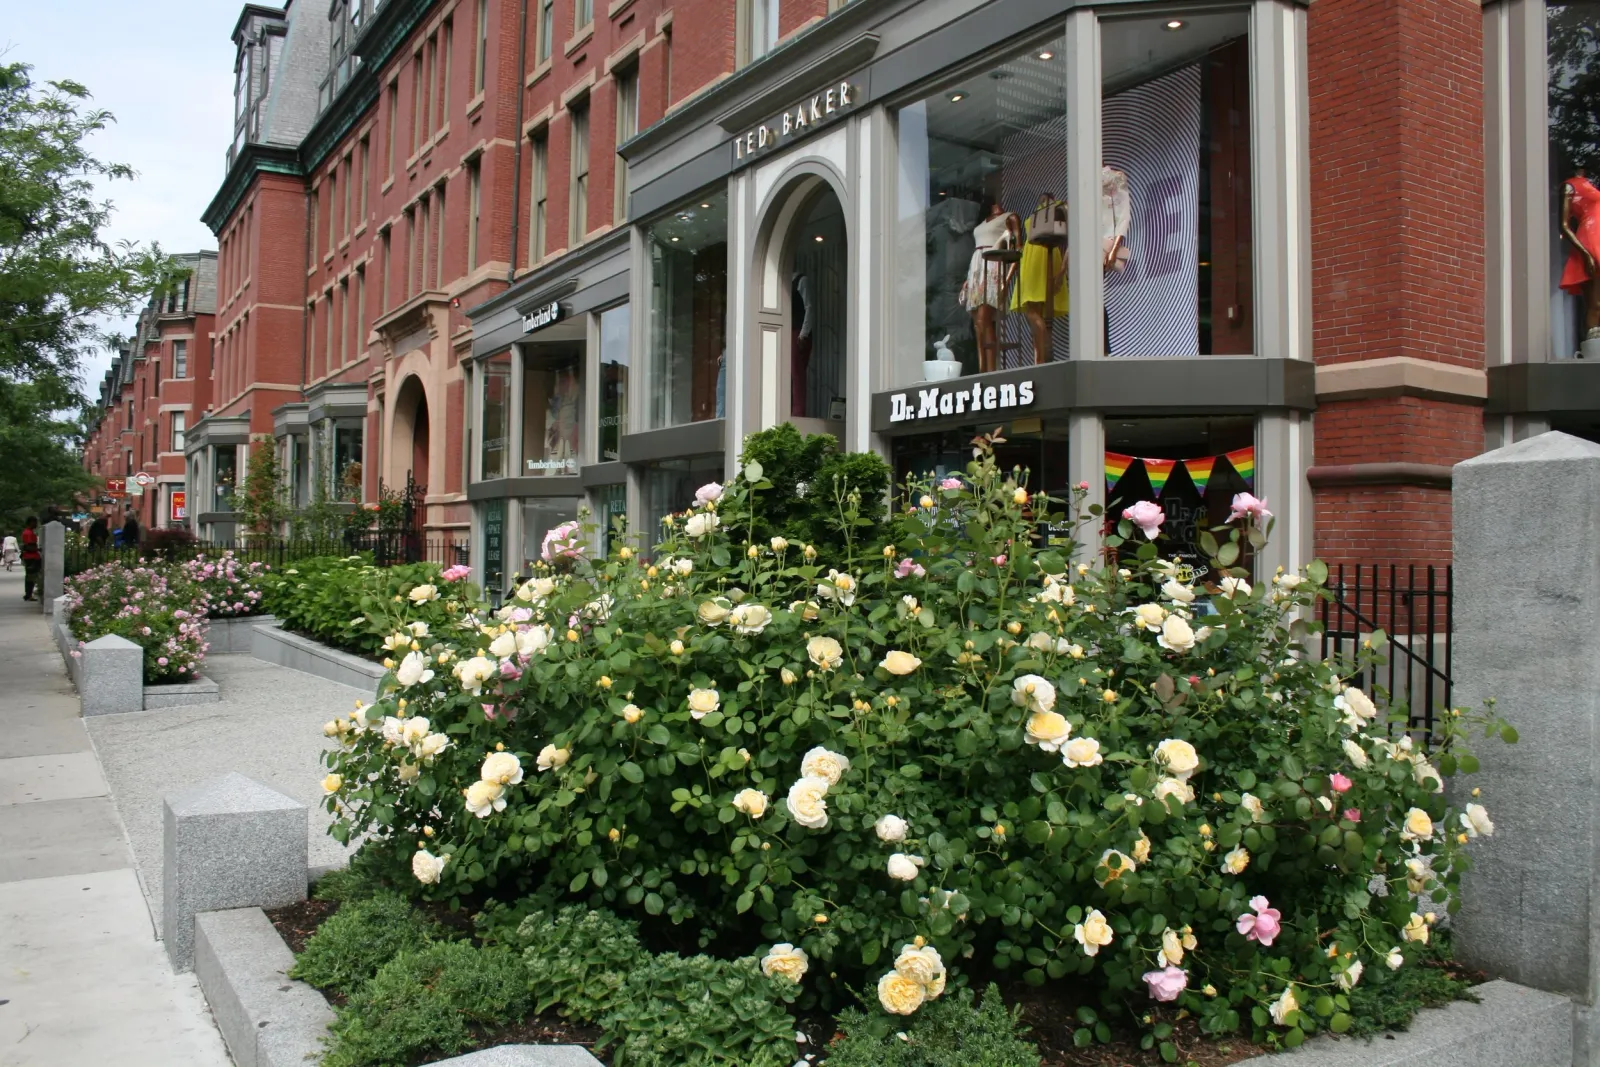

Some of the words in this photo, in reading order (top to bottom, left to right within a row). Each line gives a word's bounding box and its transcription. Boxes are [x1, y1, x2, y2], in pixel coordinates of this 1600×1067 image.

[736, 125, 768, 159] TED
[782, 81, 852, 135] BAKER
[522, 303, 551, 333] Timberland
[890, 393, 915, 422] Dr.
[918, 381, 1034, 418] Martens
[526, 458, 565, 469] Timberland
[488, 550, 500, 561] LEASE
